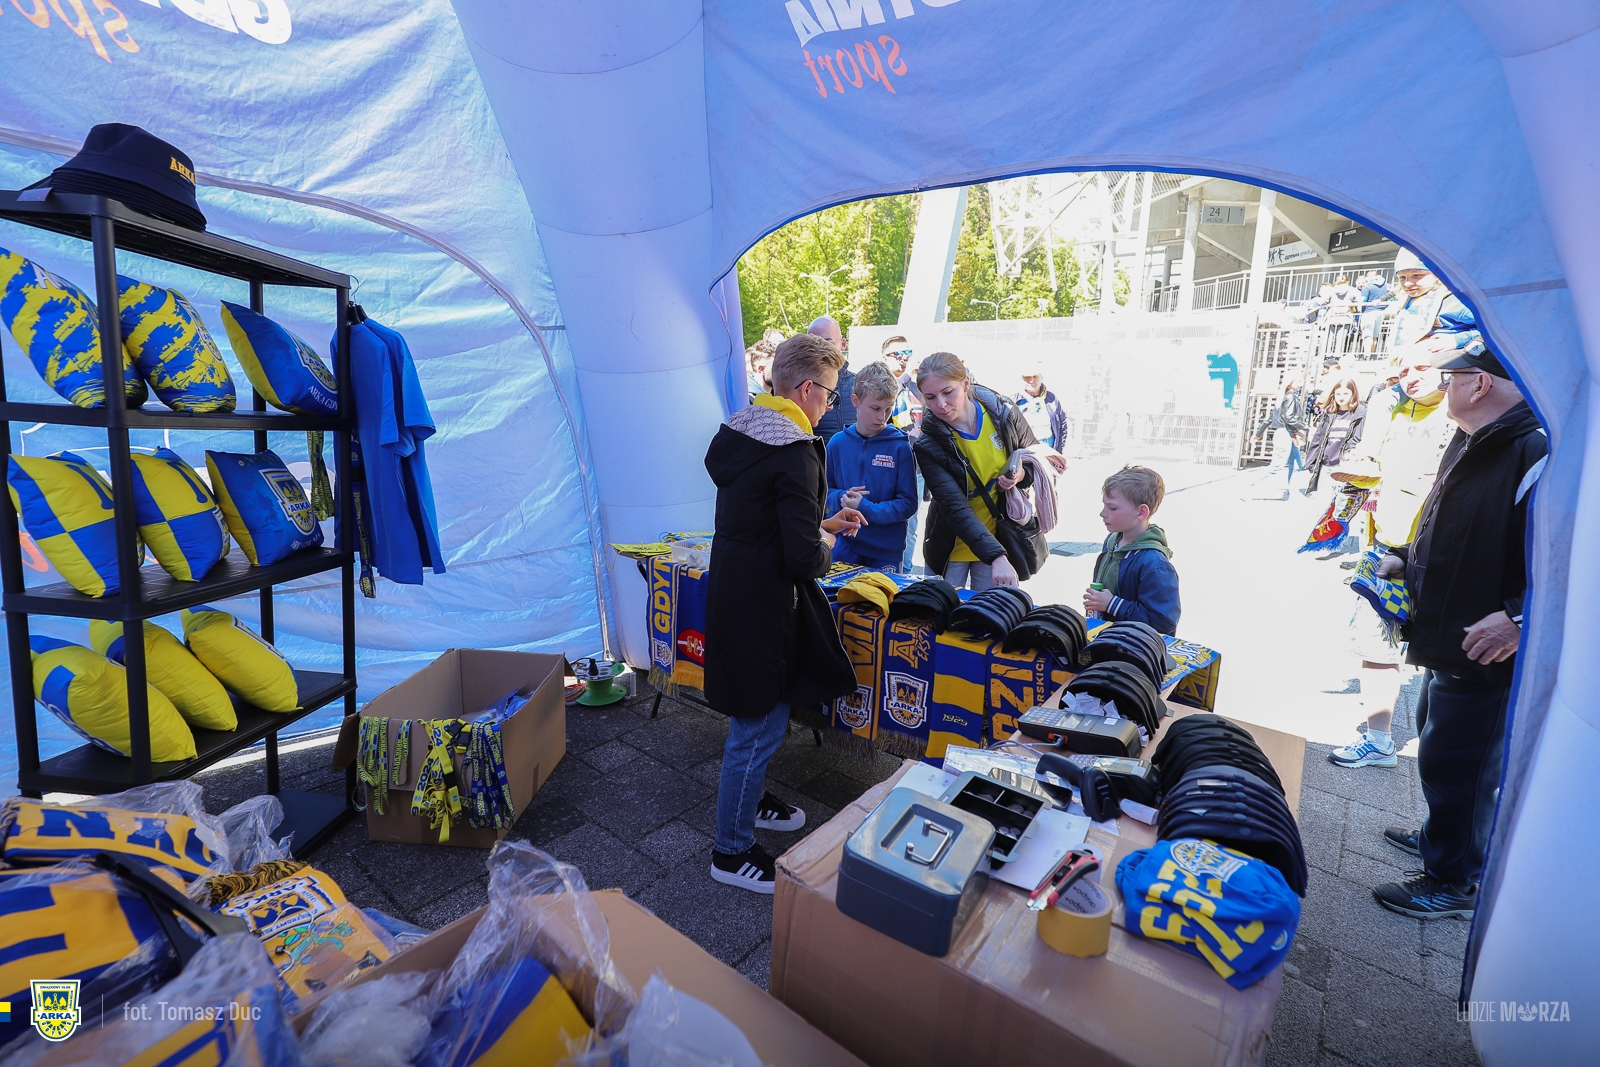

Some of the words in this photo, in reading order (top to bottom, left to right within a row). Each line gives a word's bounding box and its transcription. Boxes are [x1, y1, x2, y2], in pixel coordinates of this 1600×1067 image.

[1209, 206, 1221, 217] 24
[1335, 232, 1343, 247] J
[290, 501, 311, 513] ARKA
[653, 558, 671, 634] GDYN
[891, 700, 921, 714] ARKA
[942, 713, 968, 727] 1929
[417, 757, 434, 791] 2024
[237, 883, 298, 911] ARKA
[1076, 888, 1096, 909] dalpo
